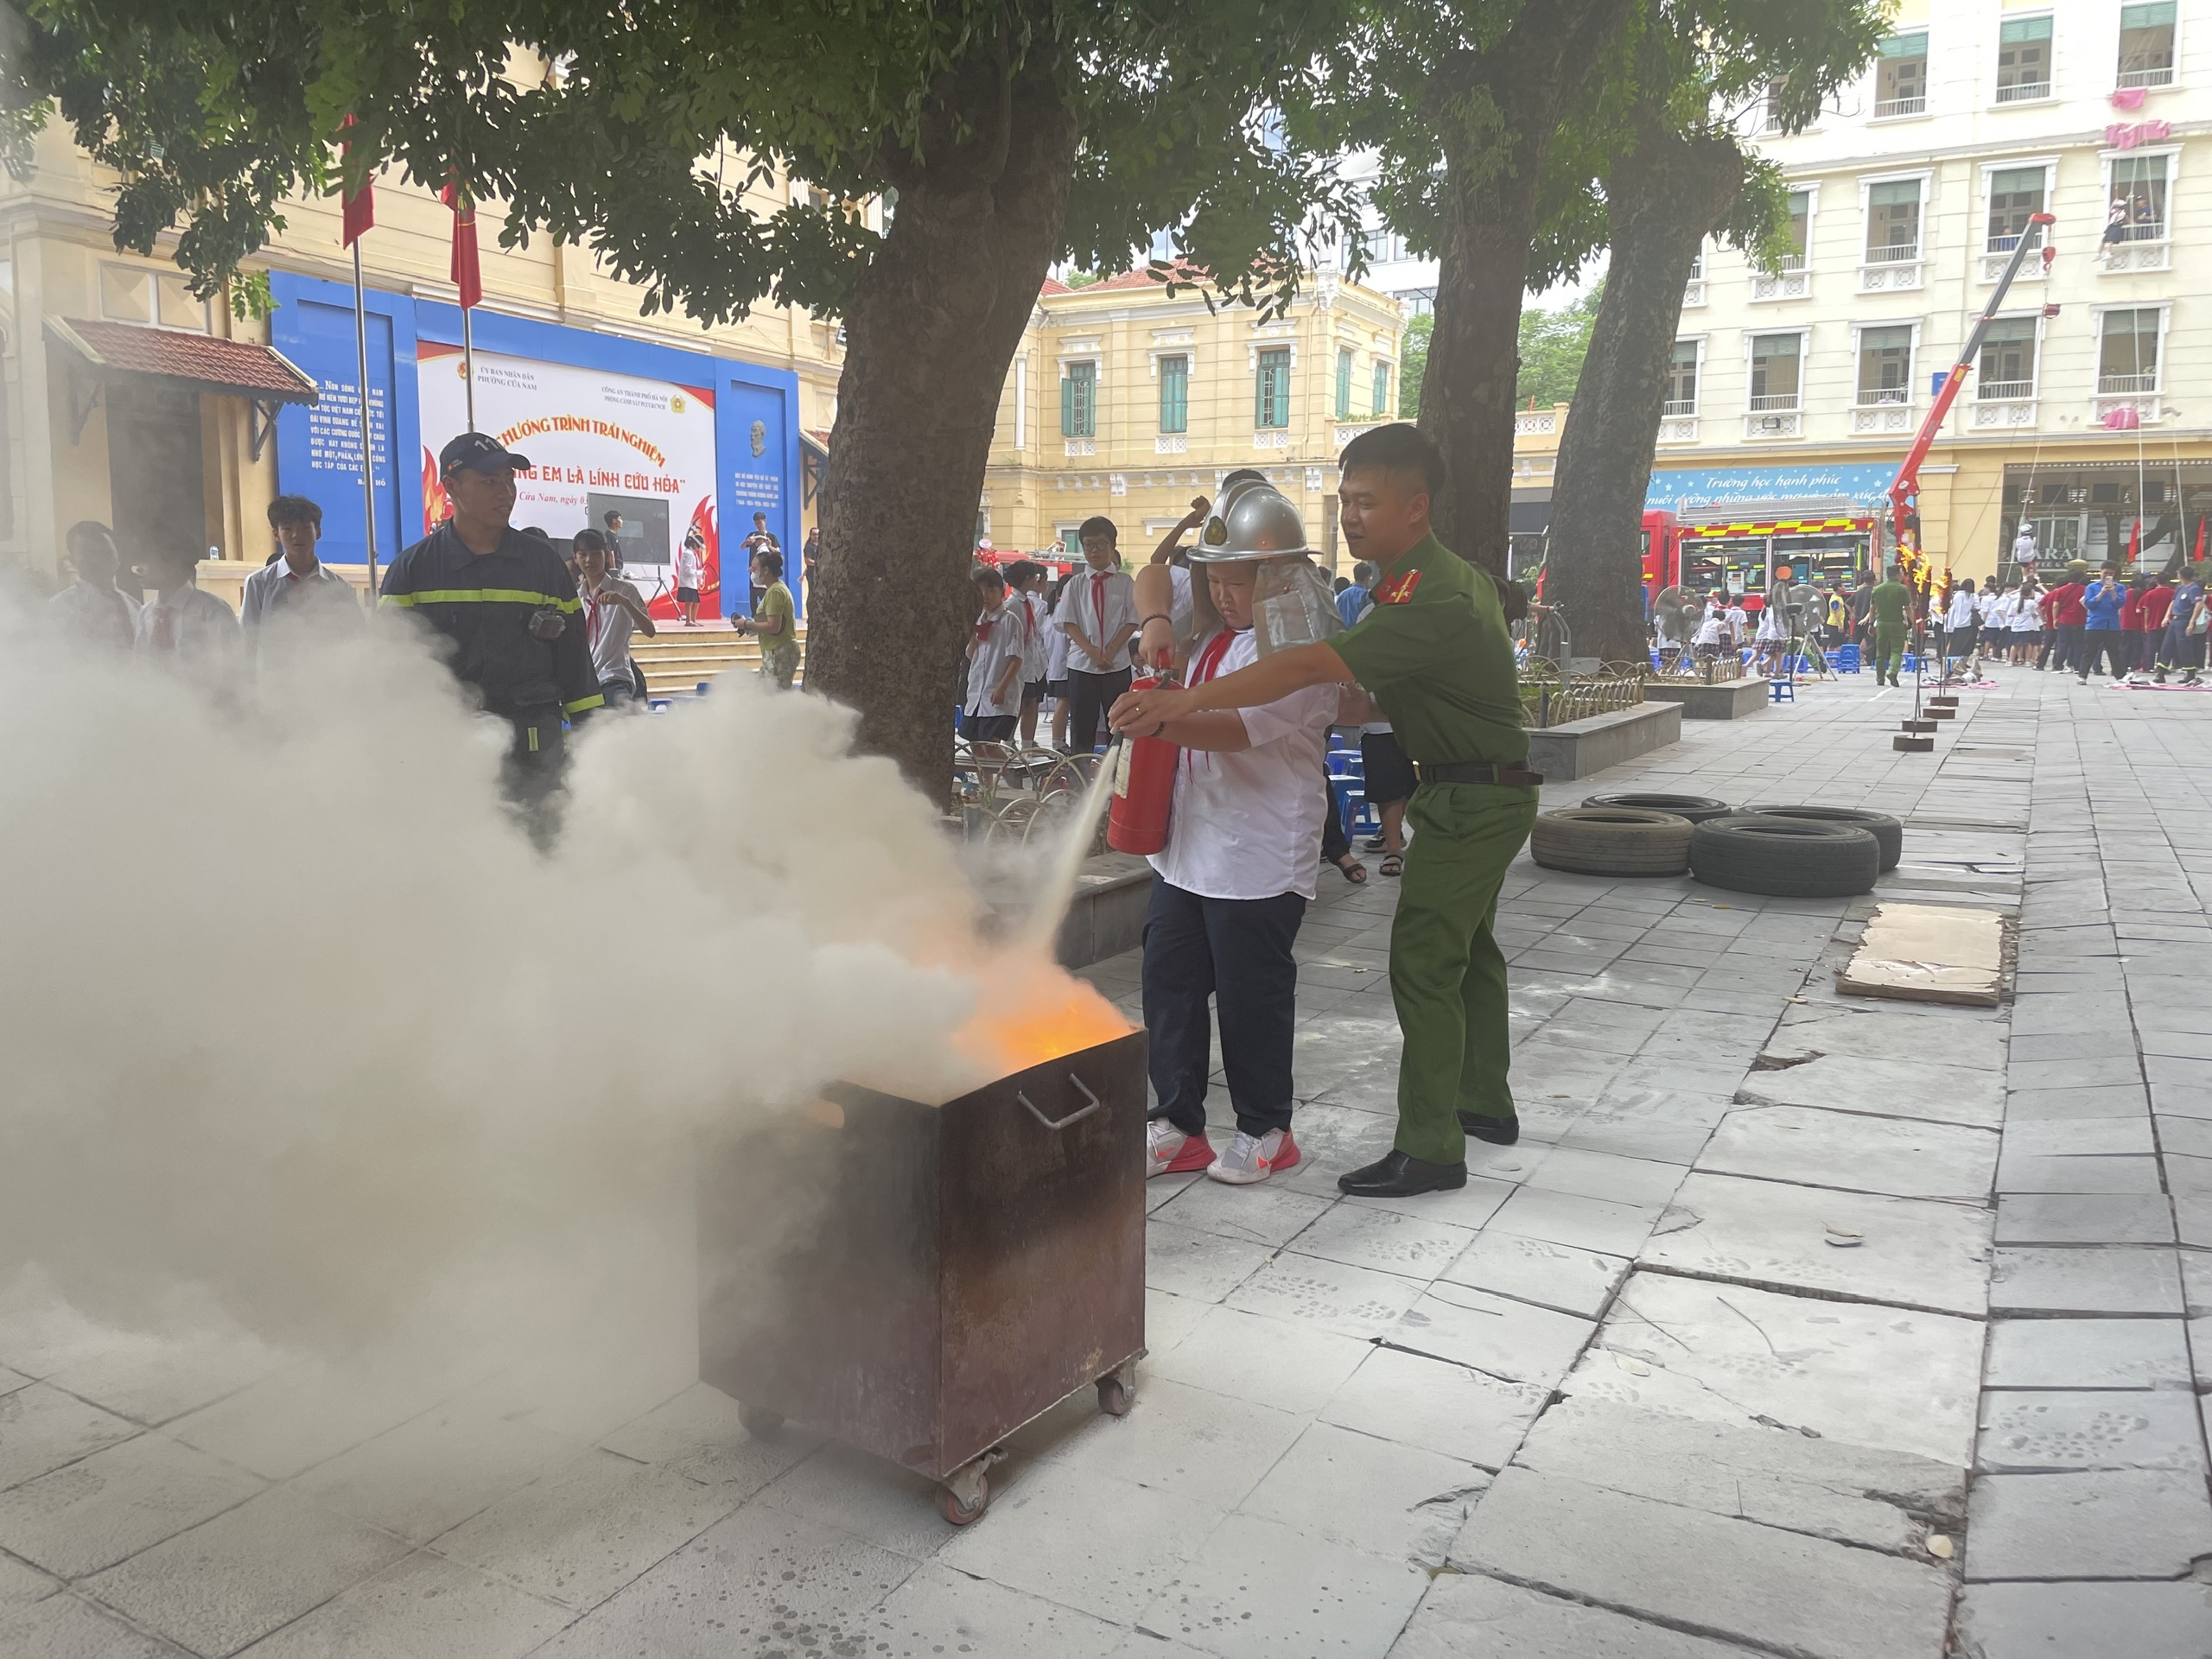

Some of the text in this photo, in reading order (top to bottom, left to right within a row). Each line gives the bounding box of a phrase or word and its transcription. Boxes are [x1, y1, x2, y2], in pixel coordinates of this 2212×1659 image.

[478, 375, 506, 385] PHƯỜNG
[504, 370, 521, 378] NHÂN
[550, 414, 591, 432] TRÌNH
[621, 431, 666, 469] NGHIỆM
[542, 466, 563, 482] EM
[567, 465, 585, 484] LÀ
[588, 467, 620, 488] LÍNH
[624, 472, 649, 491] CỨU
[1707, 474, 1843, 491] Trường học hạnh phúc
